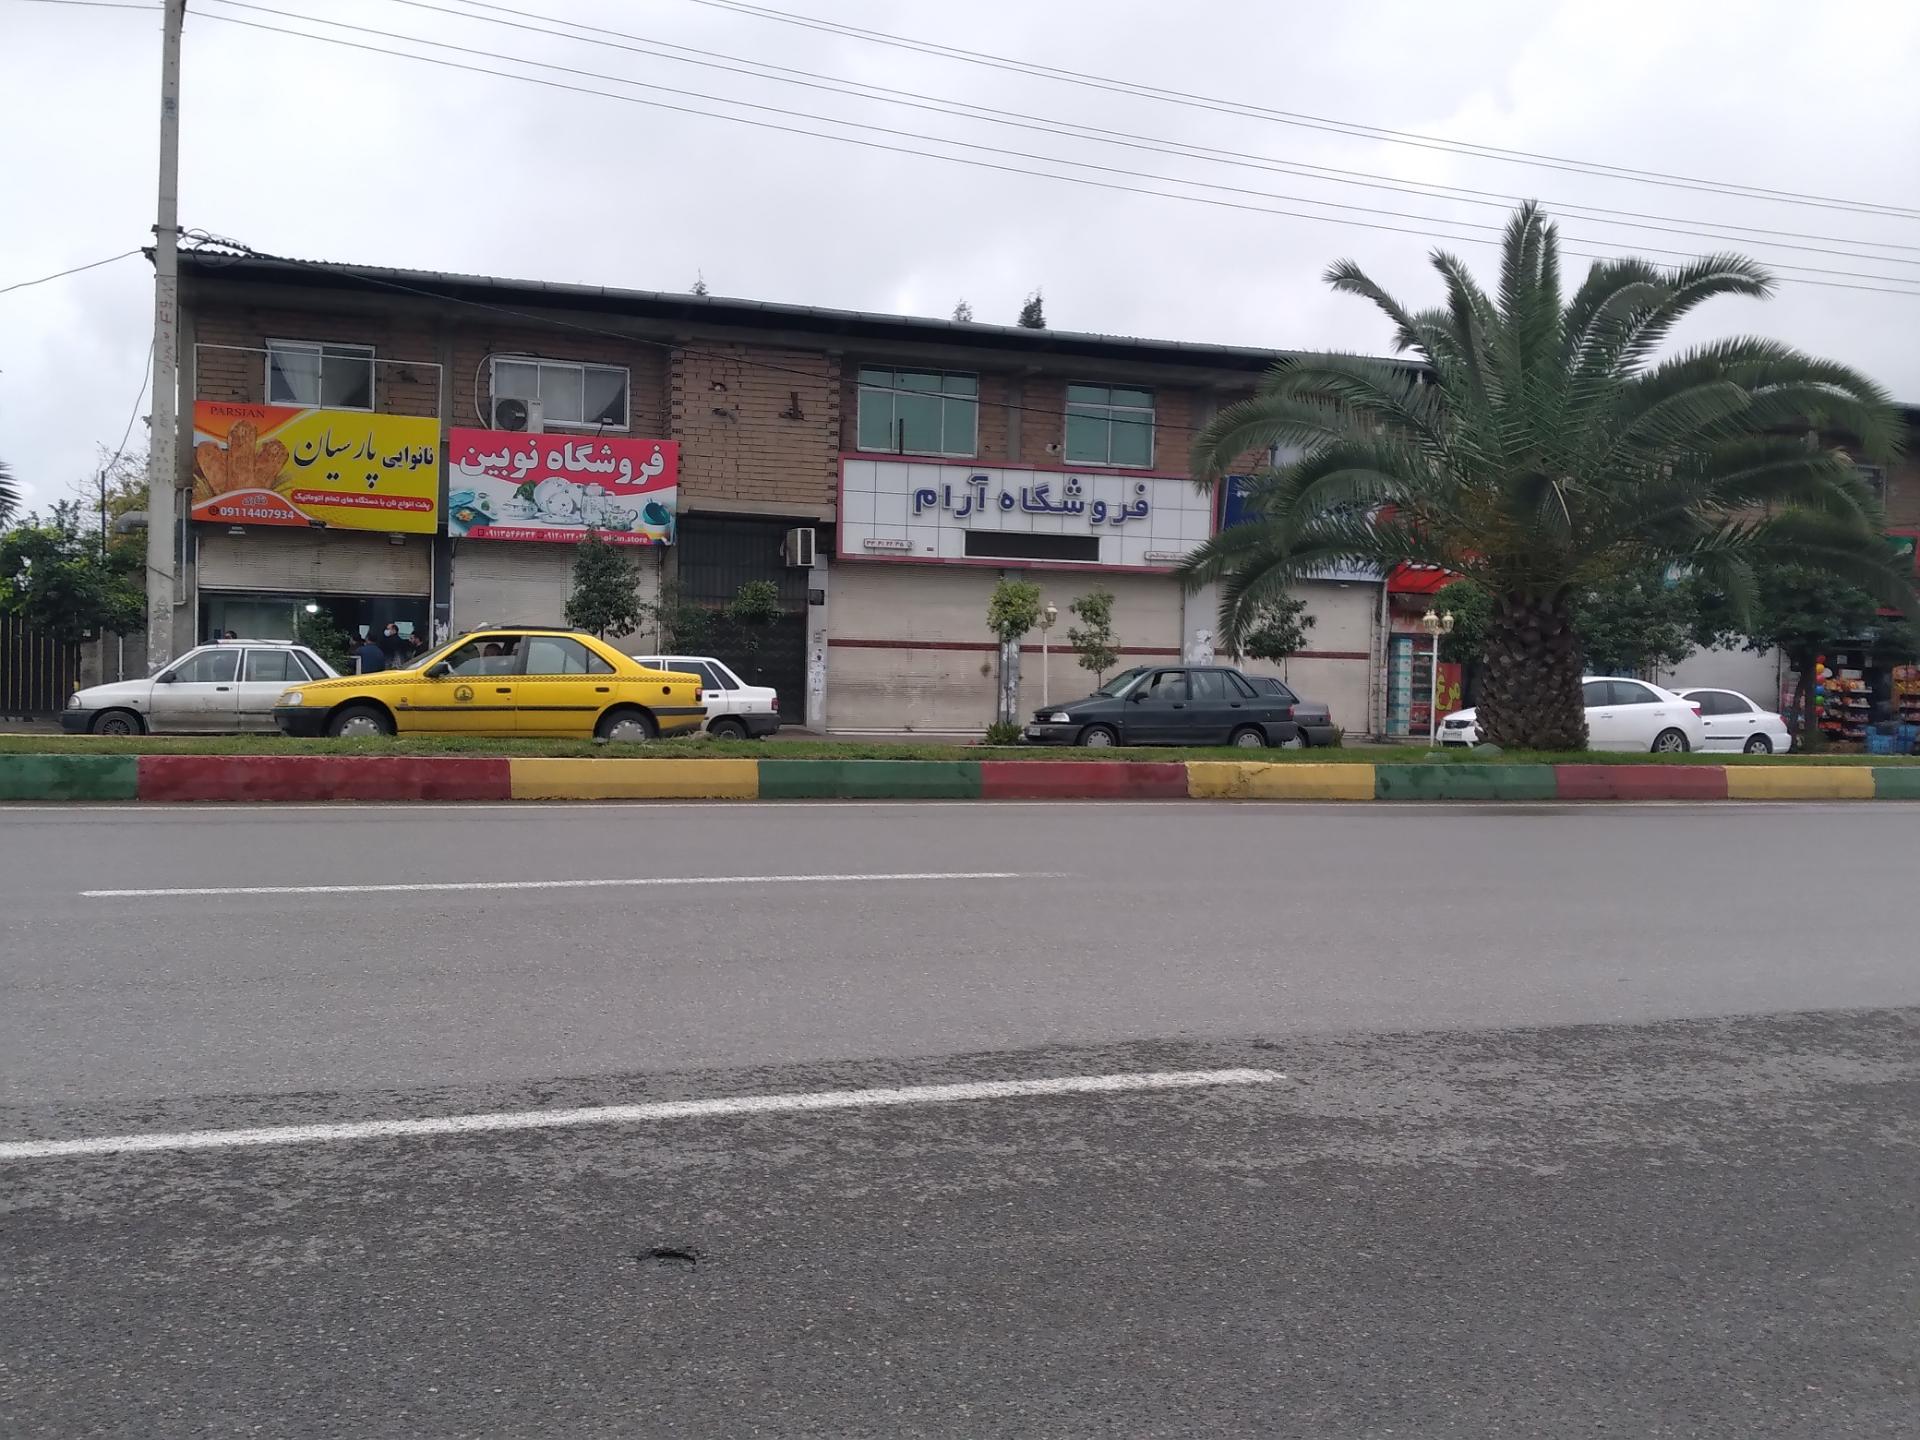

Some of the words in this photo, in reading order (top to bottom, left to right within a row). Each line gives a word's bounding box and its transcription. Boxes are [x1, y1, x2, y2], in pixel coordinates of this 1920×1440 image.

[210, 406, 265, 419] PARSIAN
[293, 428, 379, 489] پارسیان
[382, 445, 434, 471] نانوایی
[459, 439, 540, 479] نوبین
[545, 440, 665, 486] فروشگاه
[219, 507, 295, 520] 09114407934
[911, 472, 990, 519] آرام
[998, 476, 1150, 526] فروشگاه
